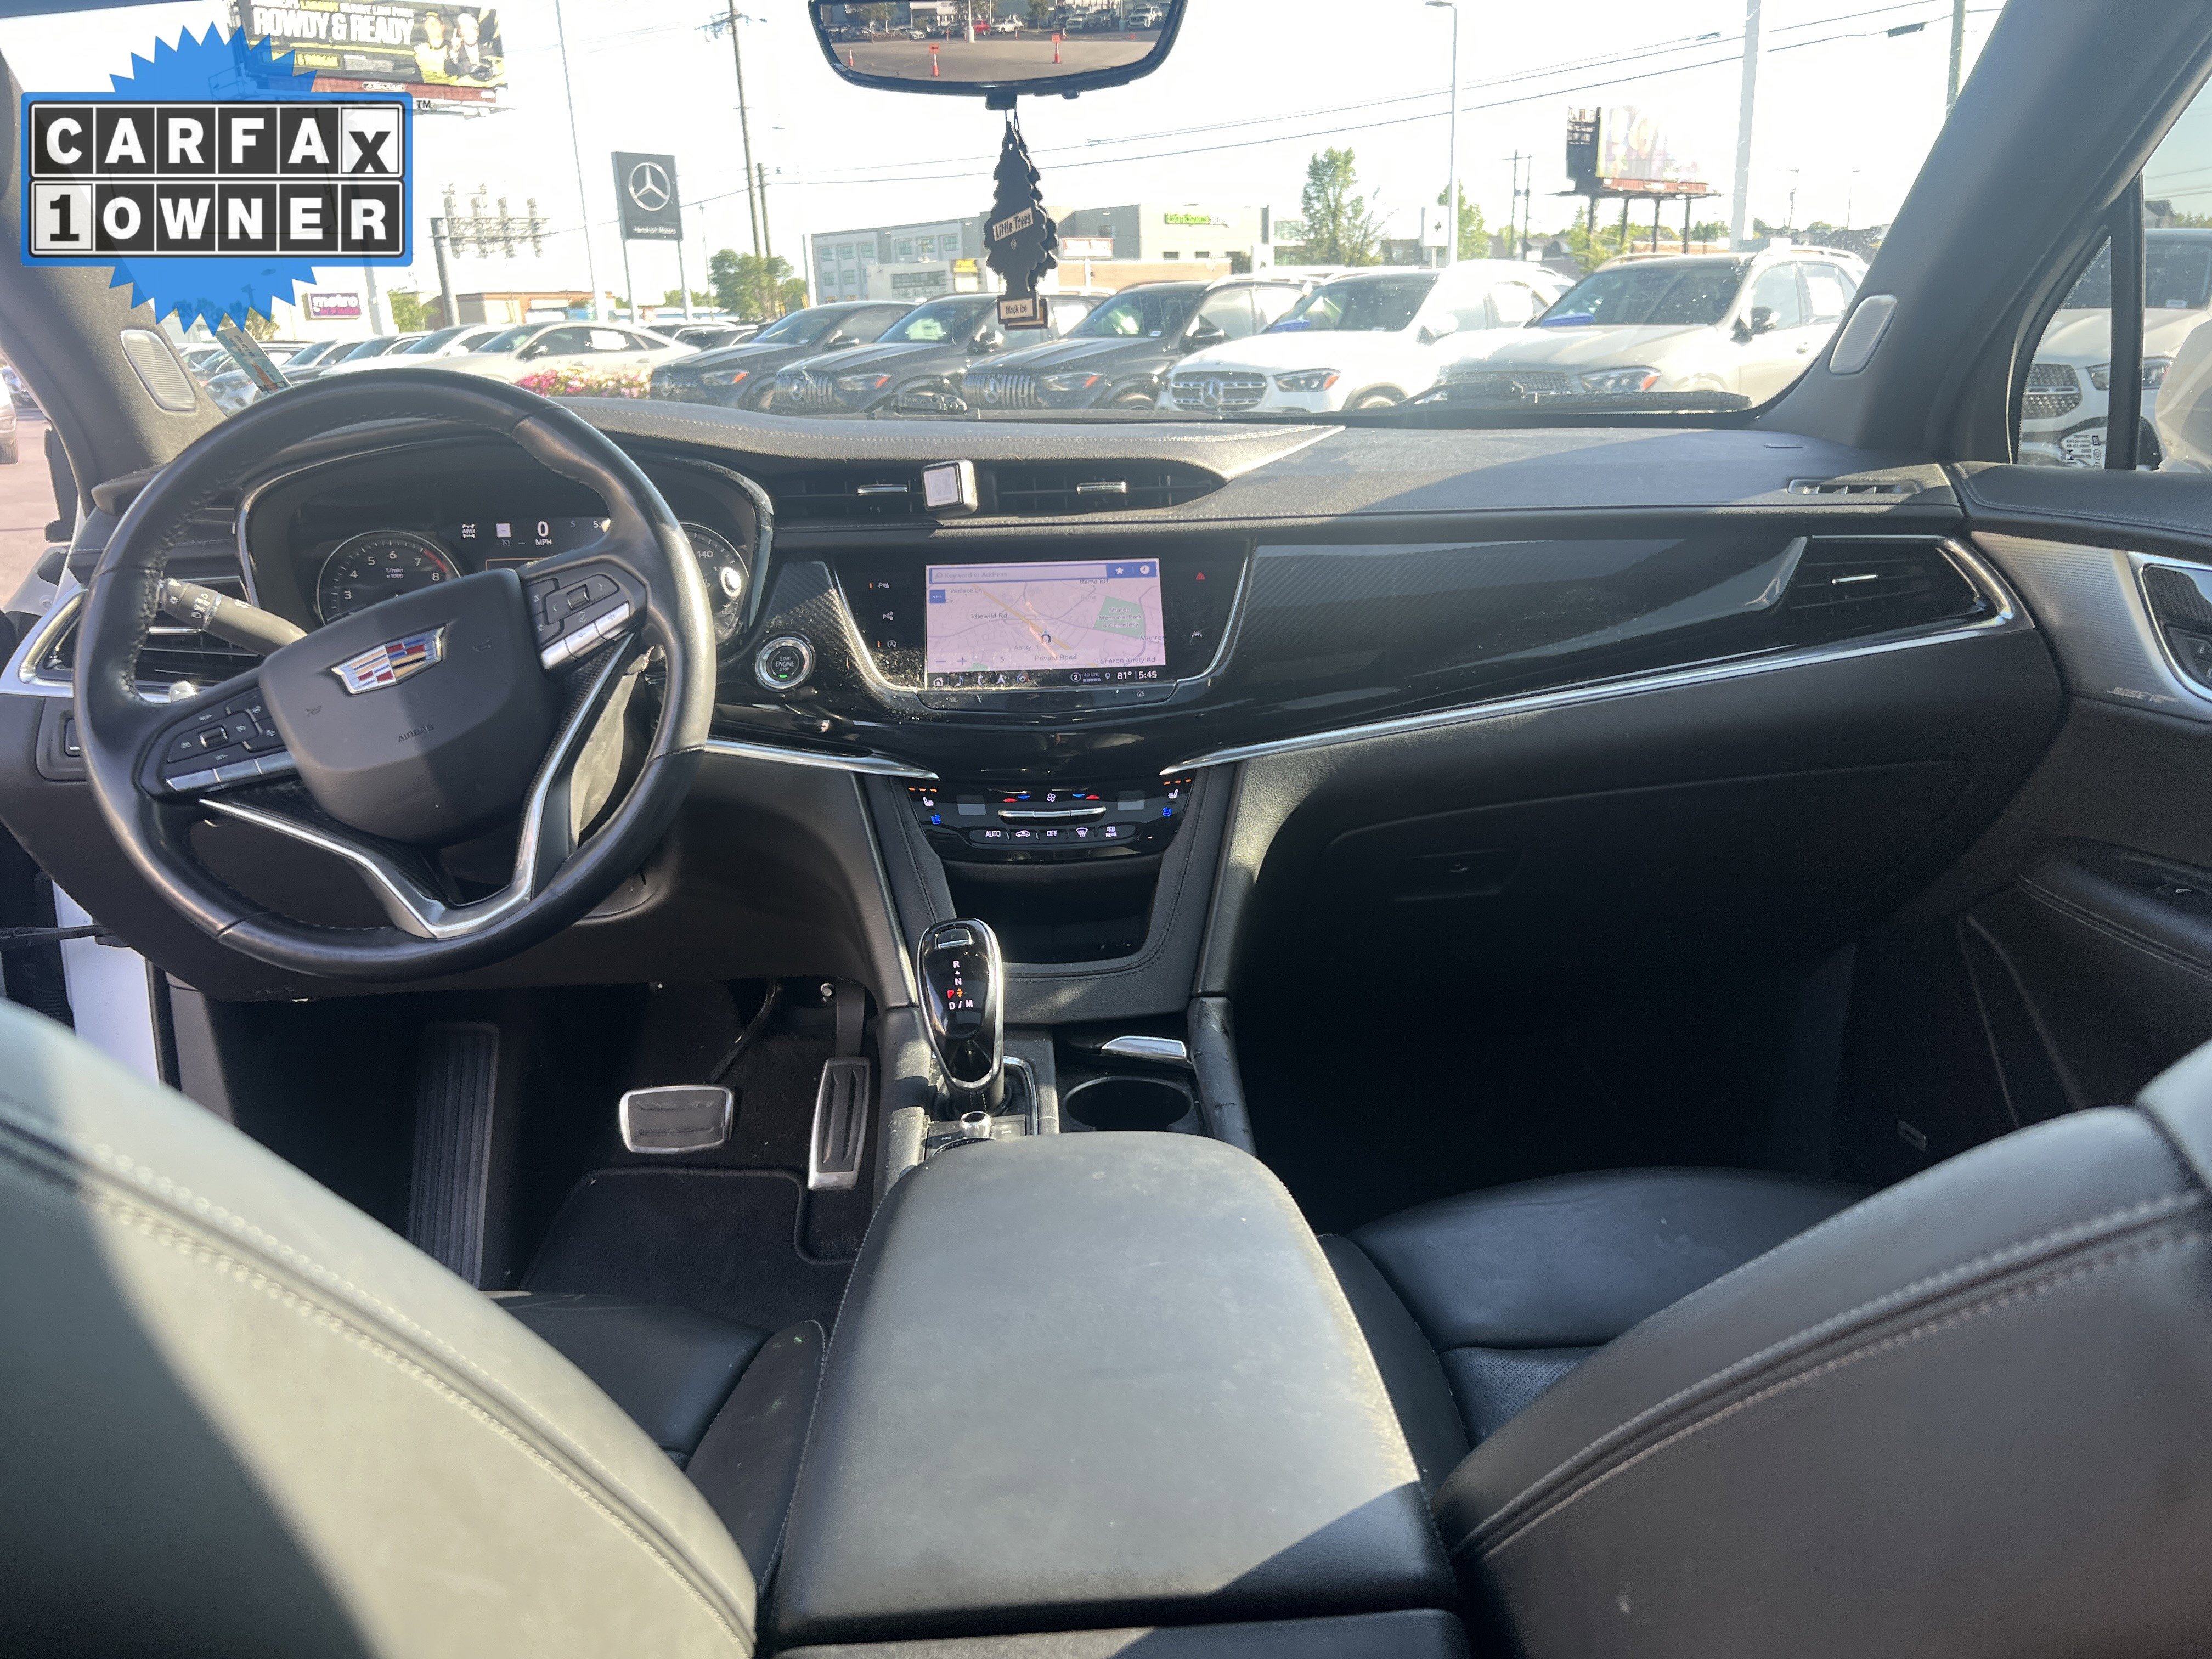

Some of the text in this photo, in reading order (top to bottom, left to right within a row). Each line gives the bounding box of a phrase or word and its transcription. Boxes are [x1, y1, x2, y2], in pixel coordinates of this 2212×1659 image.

[253, 7, 330, 40] ROWDY
[332, 16, 347, 41] &
[349, 15, 414, 45] READY
[995, 213, 1031, 238] Little Trees
[1006, 306, 1019, 315] Black
[537, 521, 549, 537] 0
[389, 550, 397, 560] 6
[697, 550, 714, 558] 140
[368, 556, 376, 566] 5
[414, 557, 422, 566] 7
[349, 569, 358, 579] 4
[432, 572, 440, 582] 8
[344, 590, 352, 600] 3
[1117, 672, 1132, 680] 81°
[2107, 687, 2152, 699] BOSE
[398, 724, 435, 743] AIRBAG
[953, 960, 960, 968] R
[955, 977, 962, 986] N
[947, 989, 955, 999] P
[966, 999, 973, 1008] M
